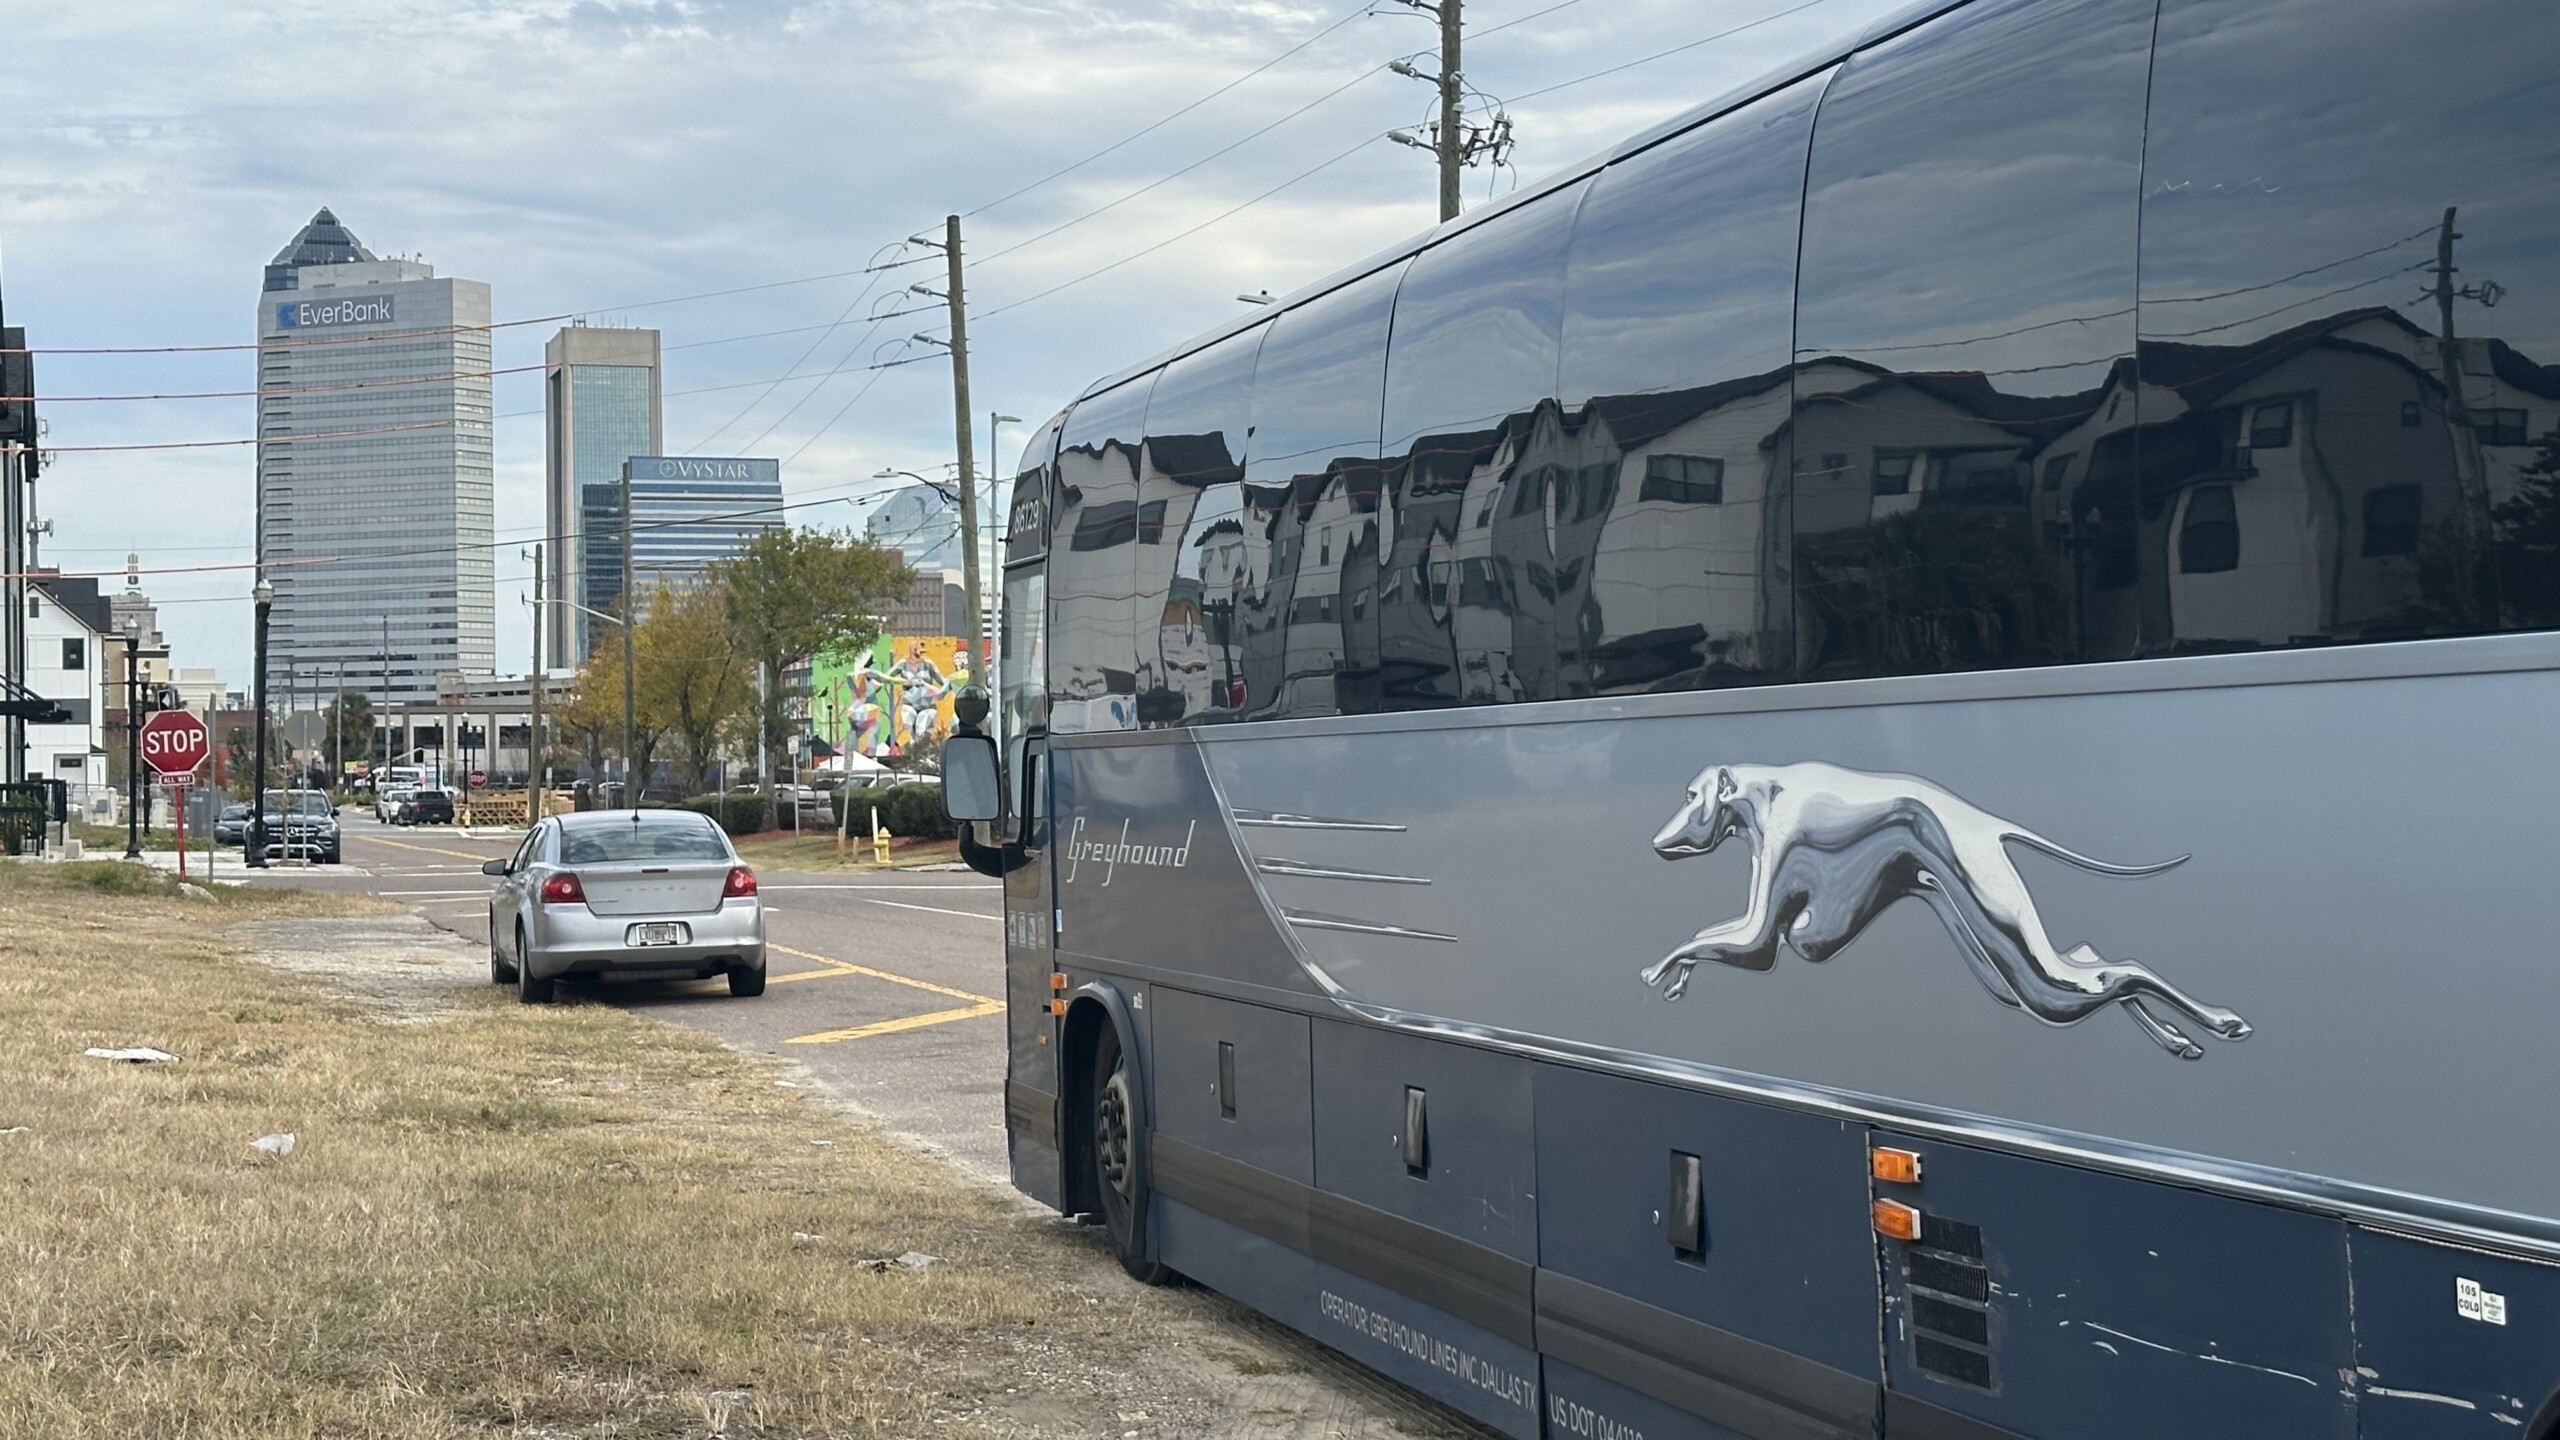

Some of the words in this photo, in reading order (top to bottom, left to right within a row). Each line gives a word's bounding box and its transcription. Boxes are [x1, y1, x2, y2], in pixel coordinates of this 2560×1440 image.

[300, 297, 391, 325] EverBank
[1014, 500, 1039, 534] 86129
[146, 729, 204, 754] STOP
[177, 775, 191, 783] WAY
[470, 774, 486, 783] STOP
[1066, 816, 1197, 887] Greyhound
[2458, 1298, 2480, 1313] COLD
[1369, 1311, 1429, 1361] GREYHOUND
[1430, 1337, 1457, 1375] LINES
[1460, 1350, 1479, 1385] INC.
[1481, 1360, 1521, 1405] DALLAS
[1523, 1379, 1537, 1414] TX
[1550, 1393, 1567, 1427] US
[1569, 1401, 1596, 1440] DOT
[1598, 1415, 1644, 1440] 044
